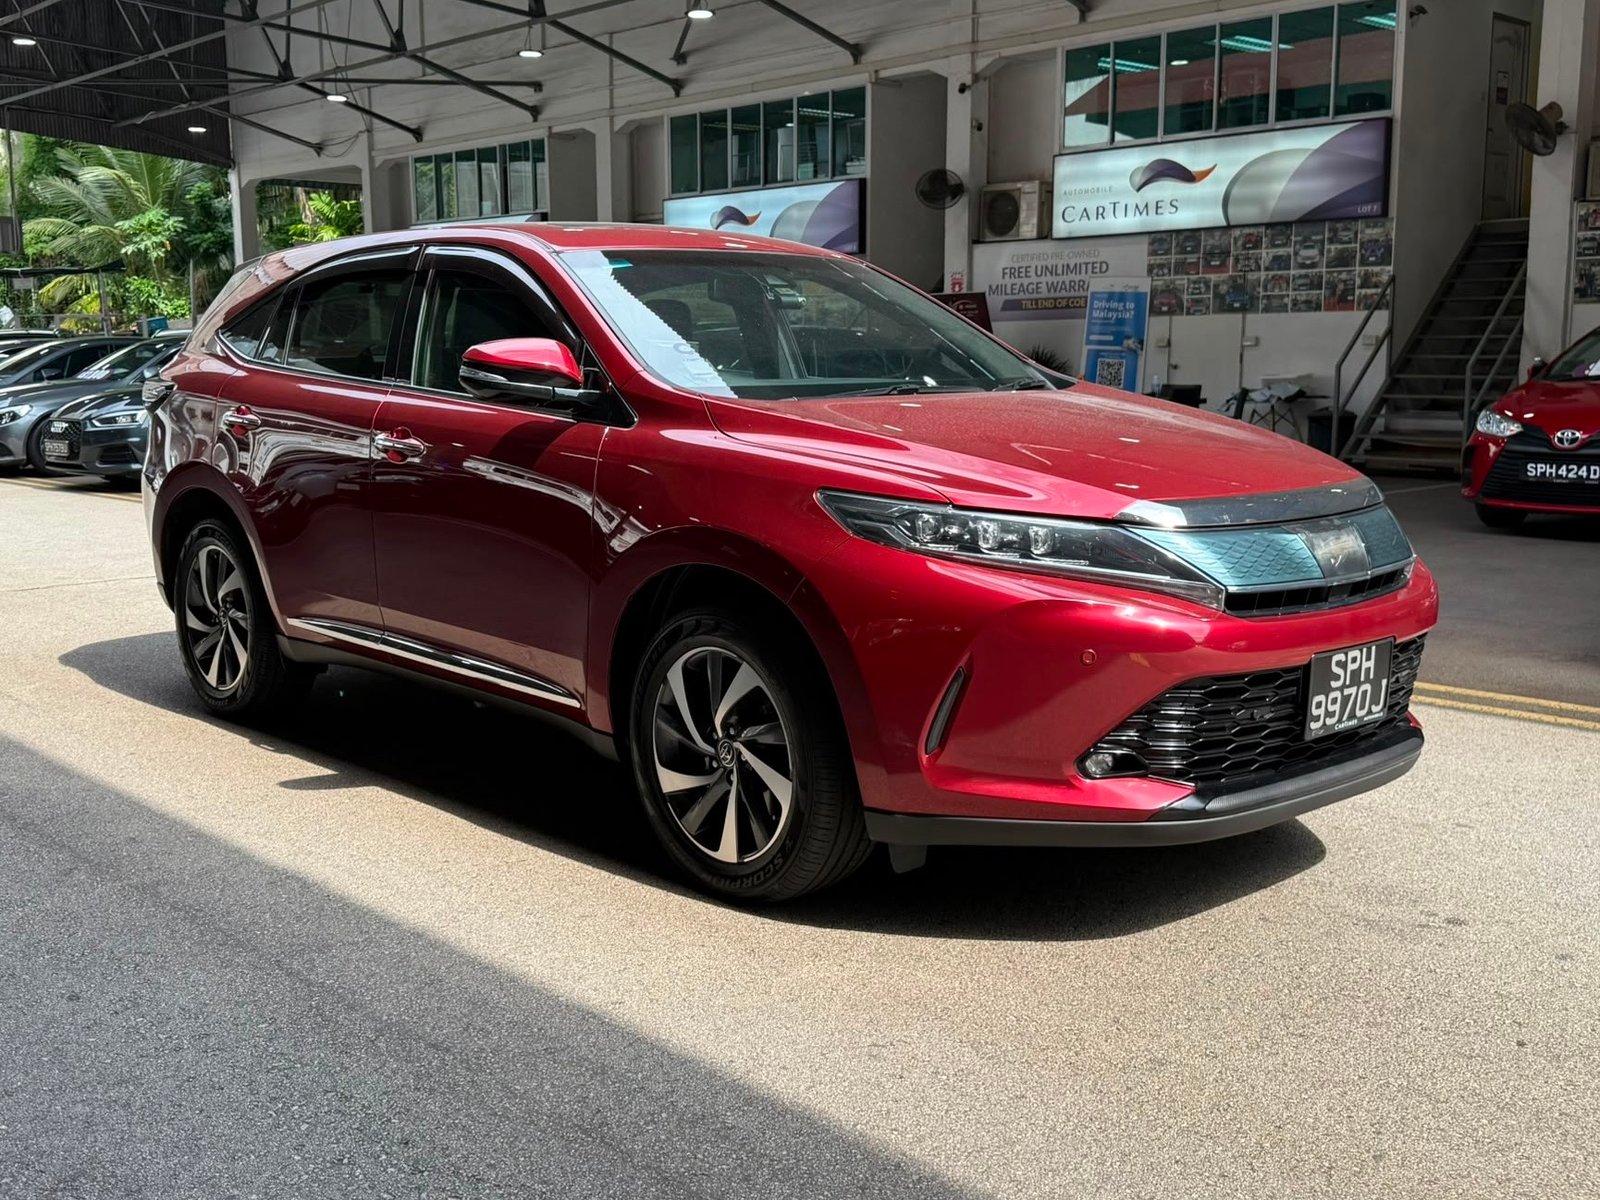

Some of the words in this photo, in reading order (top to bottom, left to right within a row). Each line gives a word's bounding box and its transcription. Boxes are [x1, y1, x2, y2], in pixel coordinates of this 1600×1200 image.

[1063, 186, 1112, 196] AUTOMOBILE
[1357, 204, 1371, 214] LOT
[1011, 252, 1049, 263] CERTIFIED
[1002, 265, 1031, 279] FREE
[1034, 261, 1109, 278] UNLIMITED
[988, 282, 1042, 297] MILEAGE
[1021, 300, 1037, 309] TILL
[1039, 299, 1055, 308] END
[1056, 299, 1068, 308] OF
[1069, 298, 1086, 307] COE
[1093, 300, 1124, 310] Driving
[1126, 301, 1135, 309] to
[1092, 310, 1135, 320] Malaysia?
[1330, 645, 1376, 688] SPH
[1310, 678, 1387, 729] 9970J
